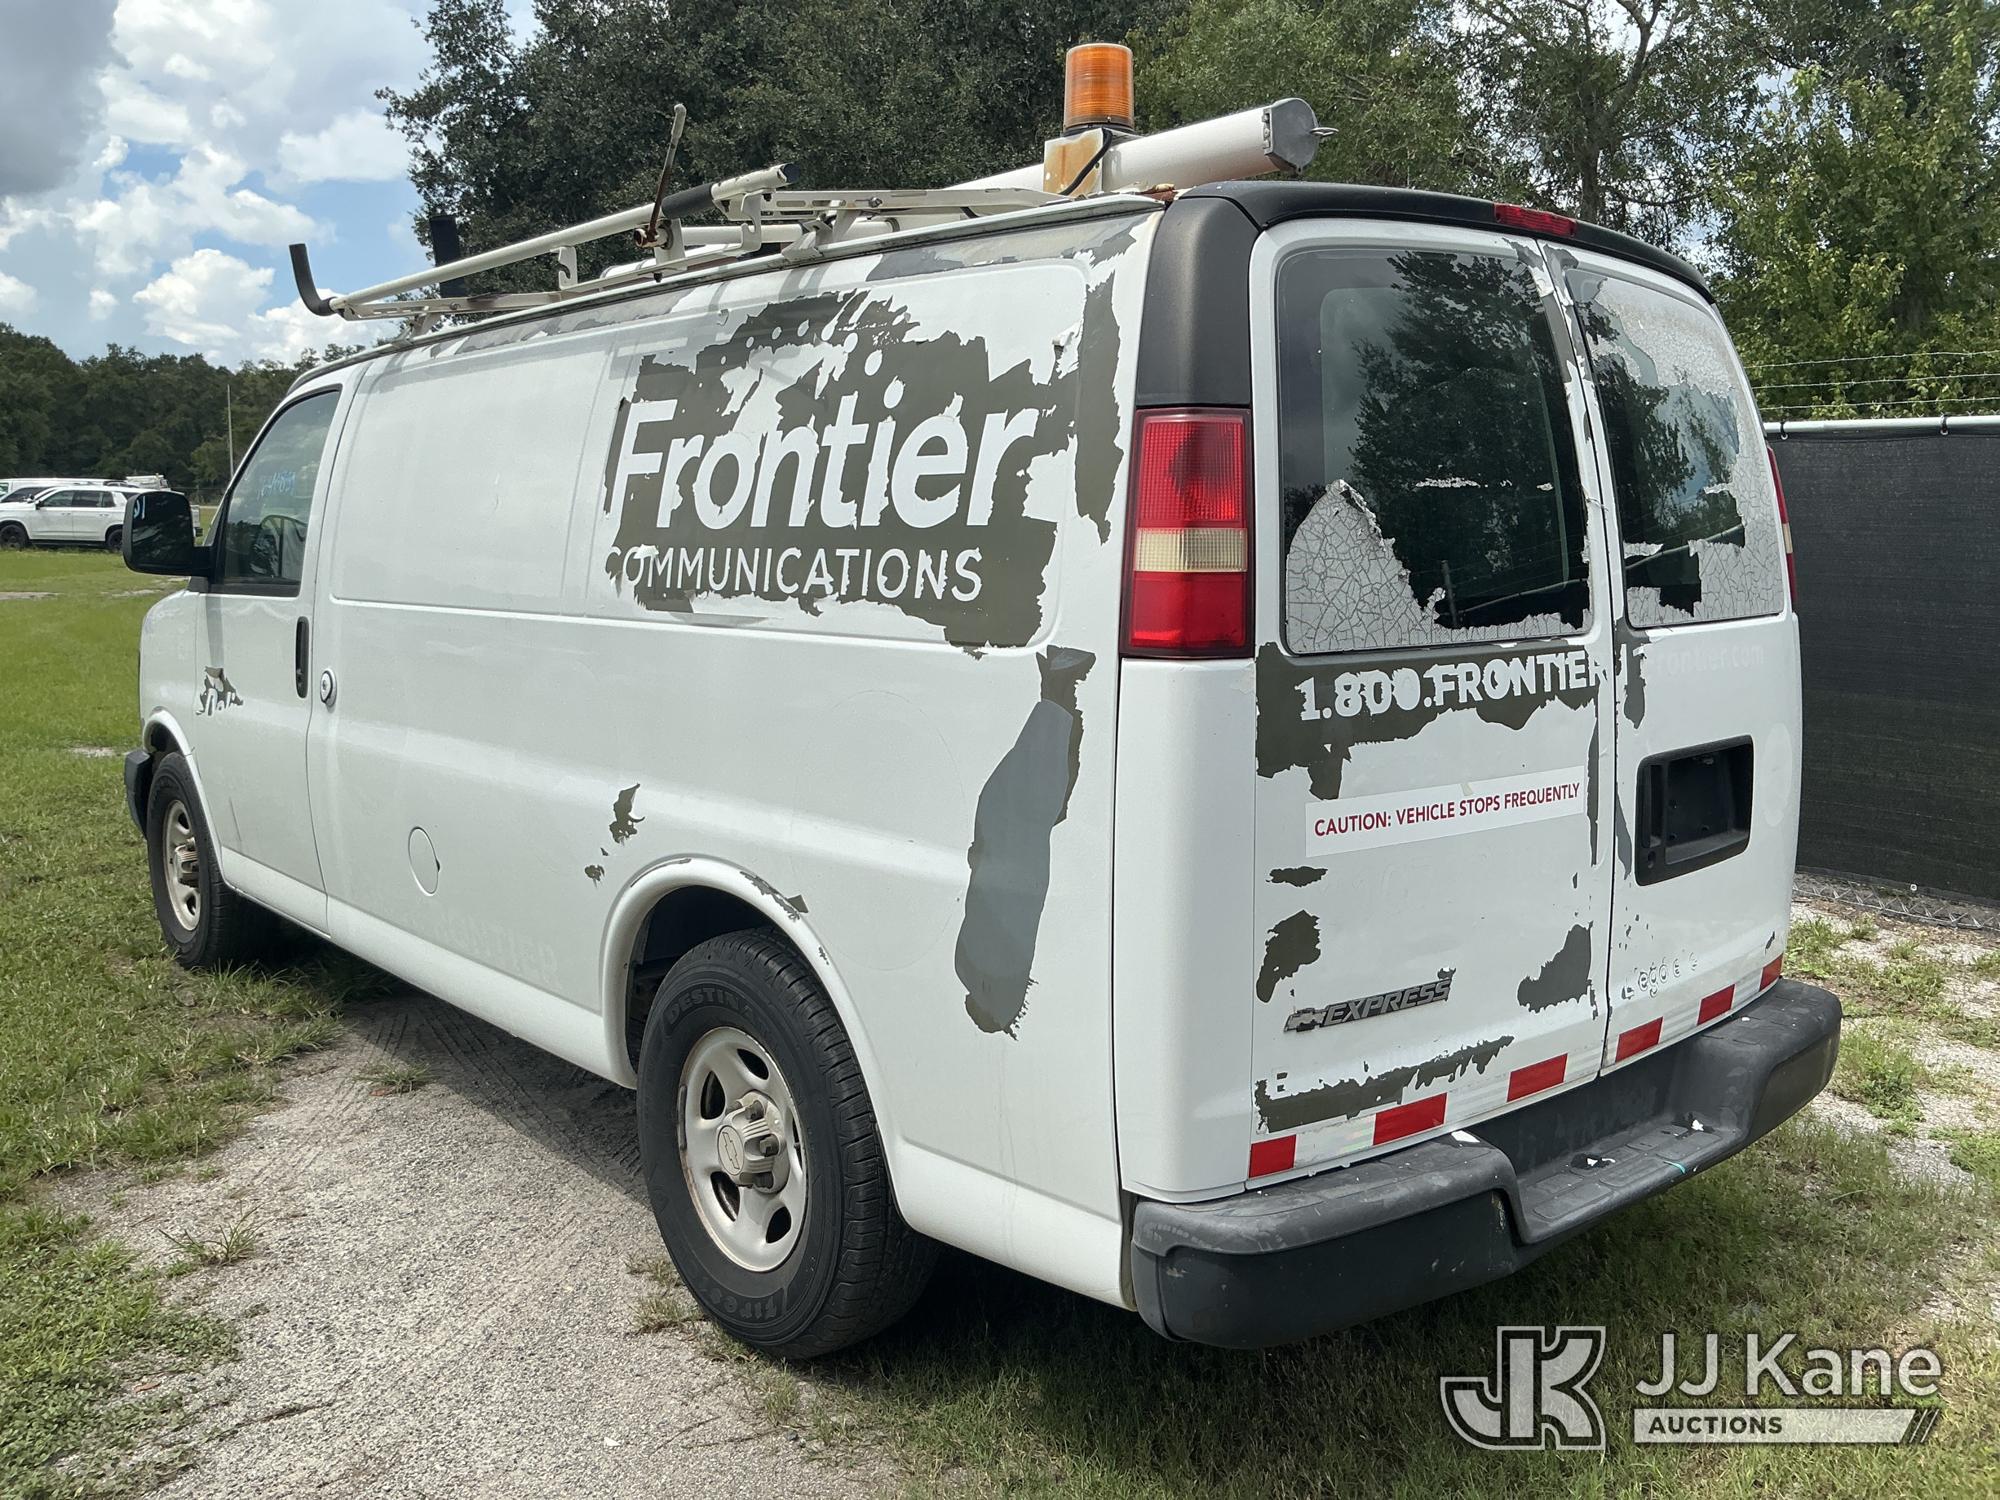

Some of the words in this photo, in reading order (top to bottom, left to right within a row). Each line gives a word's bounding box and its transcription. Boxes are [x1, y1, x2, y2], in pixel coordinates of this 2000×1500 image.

[611, 376, 1039, 529] Frontier
[605, 545, 983, 602] COMMUNICATIONS
[1314, 811, 1392, 837] CAUTION:
[1396, 801, 1456, 826] VEHICLE
[1458, 794, 1501, 817] STOPS
[1503, 782, 1581, 810] FREQUENTLY
[1323, 979, 1452, 1027] EXPRESS
